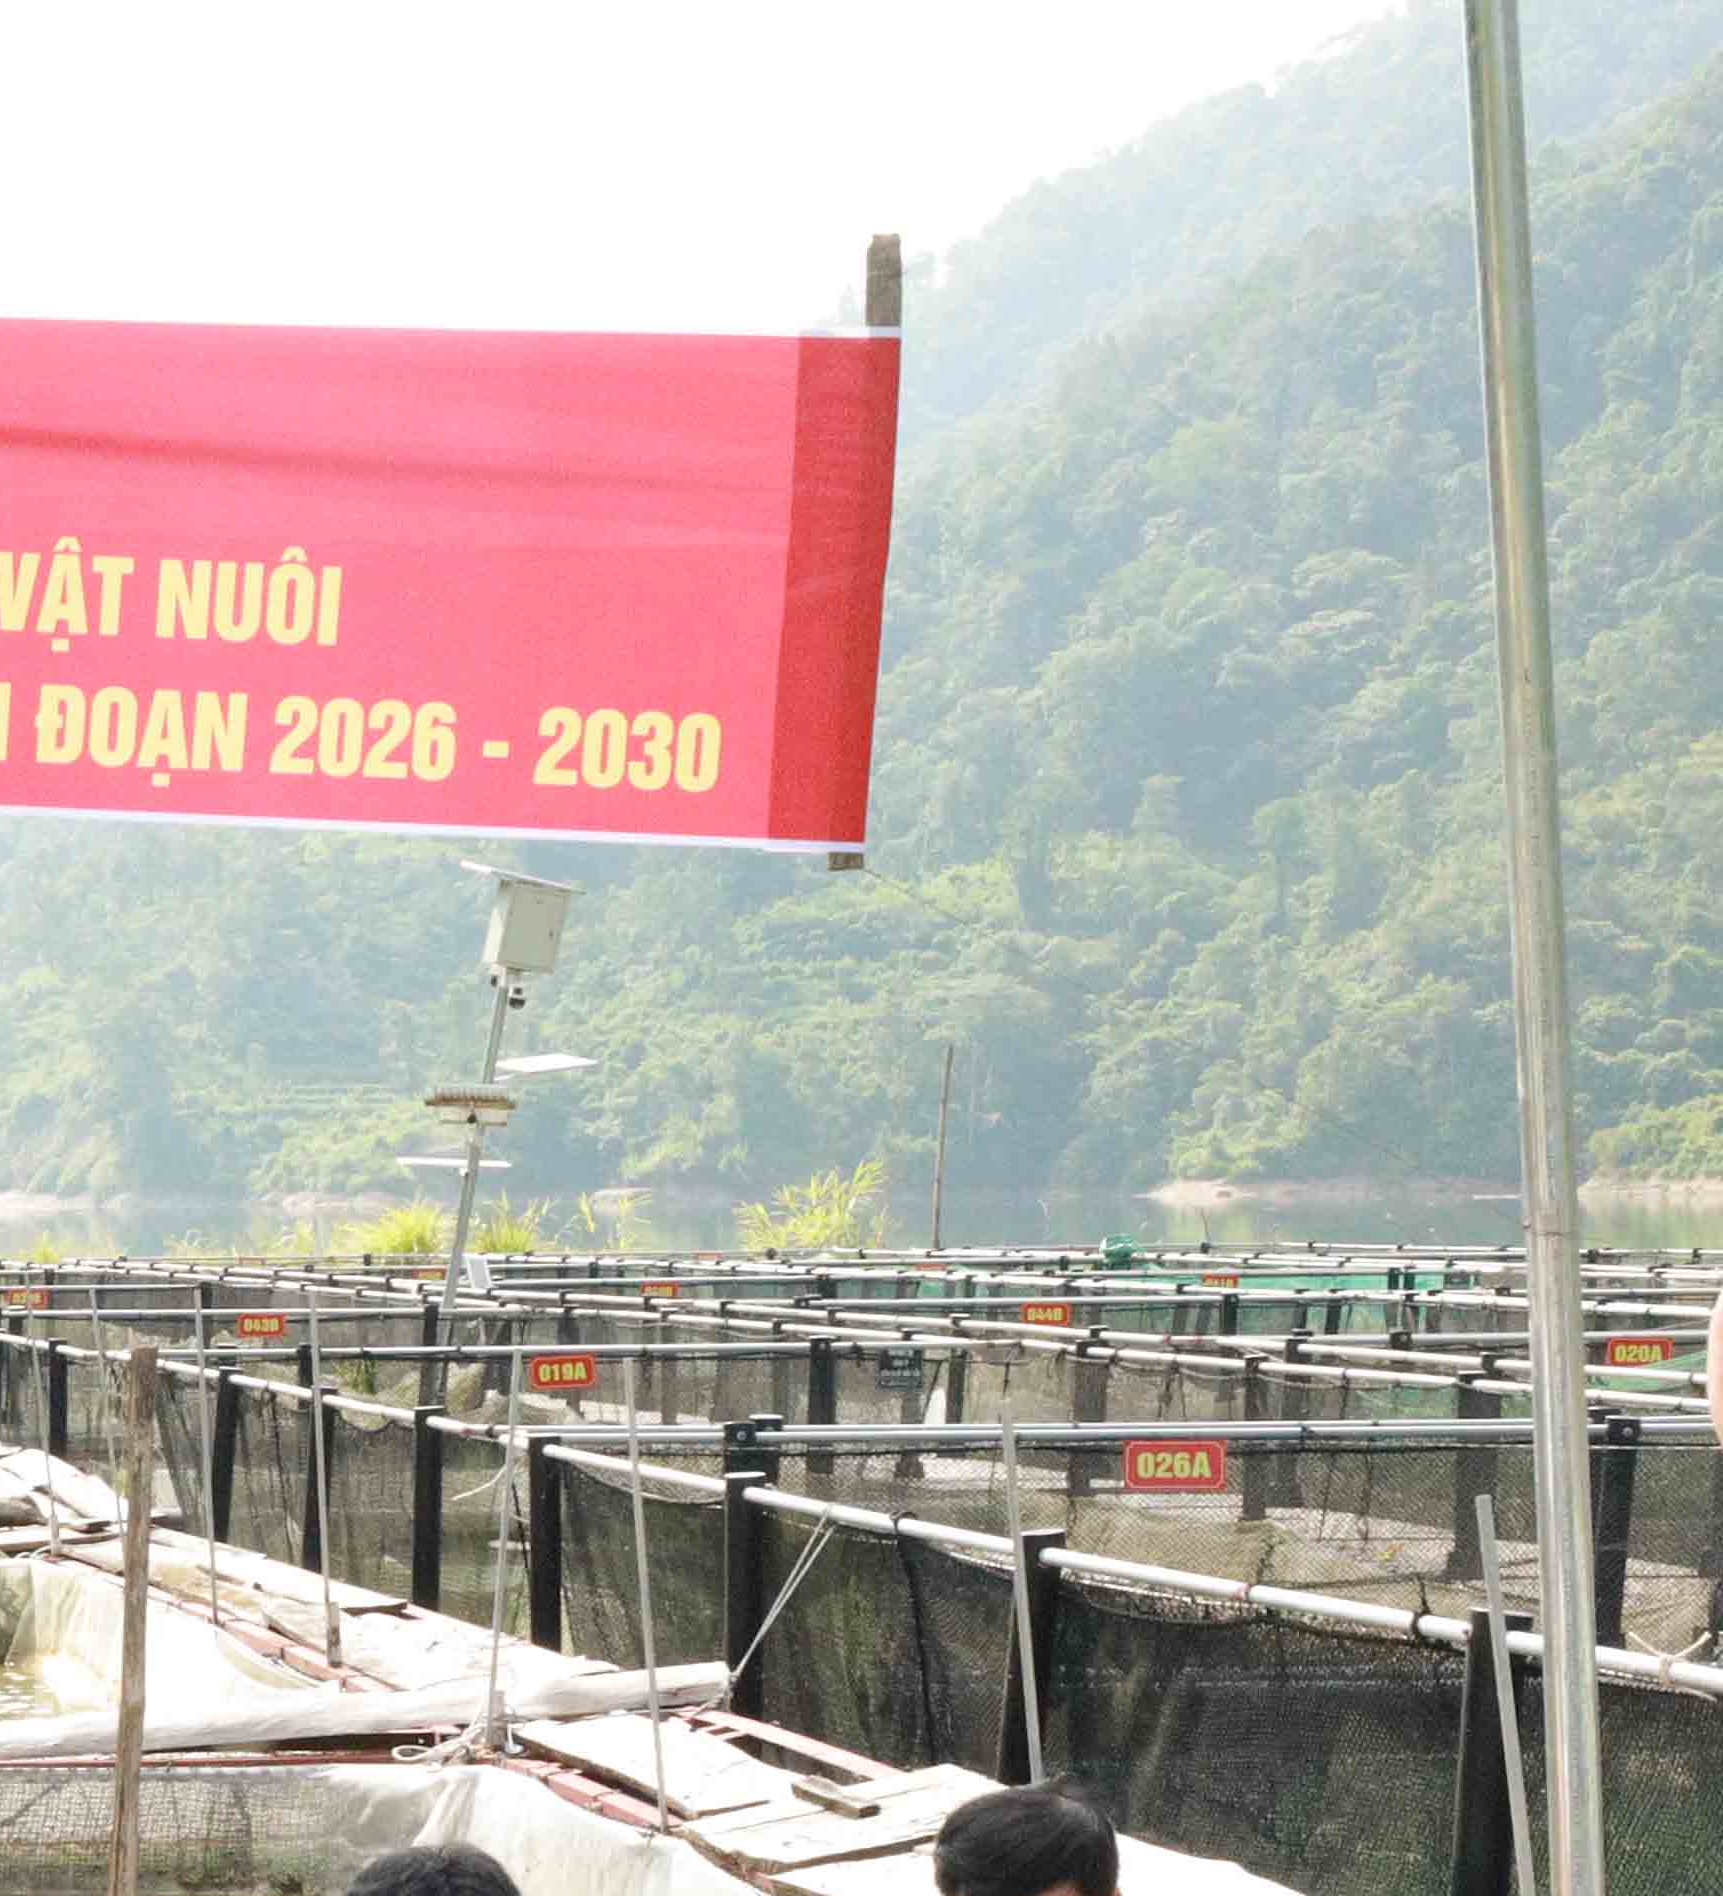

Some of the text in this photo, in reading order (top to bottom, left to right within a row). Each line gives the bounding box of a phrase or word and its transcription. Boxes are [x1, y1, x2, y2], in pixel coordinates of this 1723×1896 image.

[154, 546, 344, 647] NUÔI
[34, 682, 249, 785] ĐOẠN
[270, 694, 458, 781] 2026
[481, 739, 511, 758] -
[533, 706, 723, 794] 2030
[538, 1361, 588, 1383] 019A
[1136, 1451, 1212, 1479] 026A
